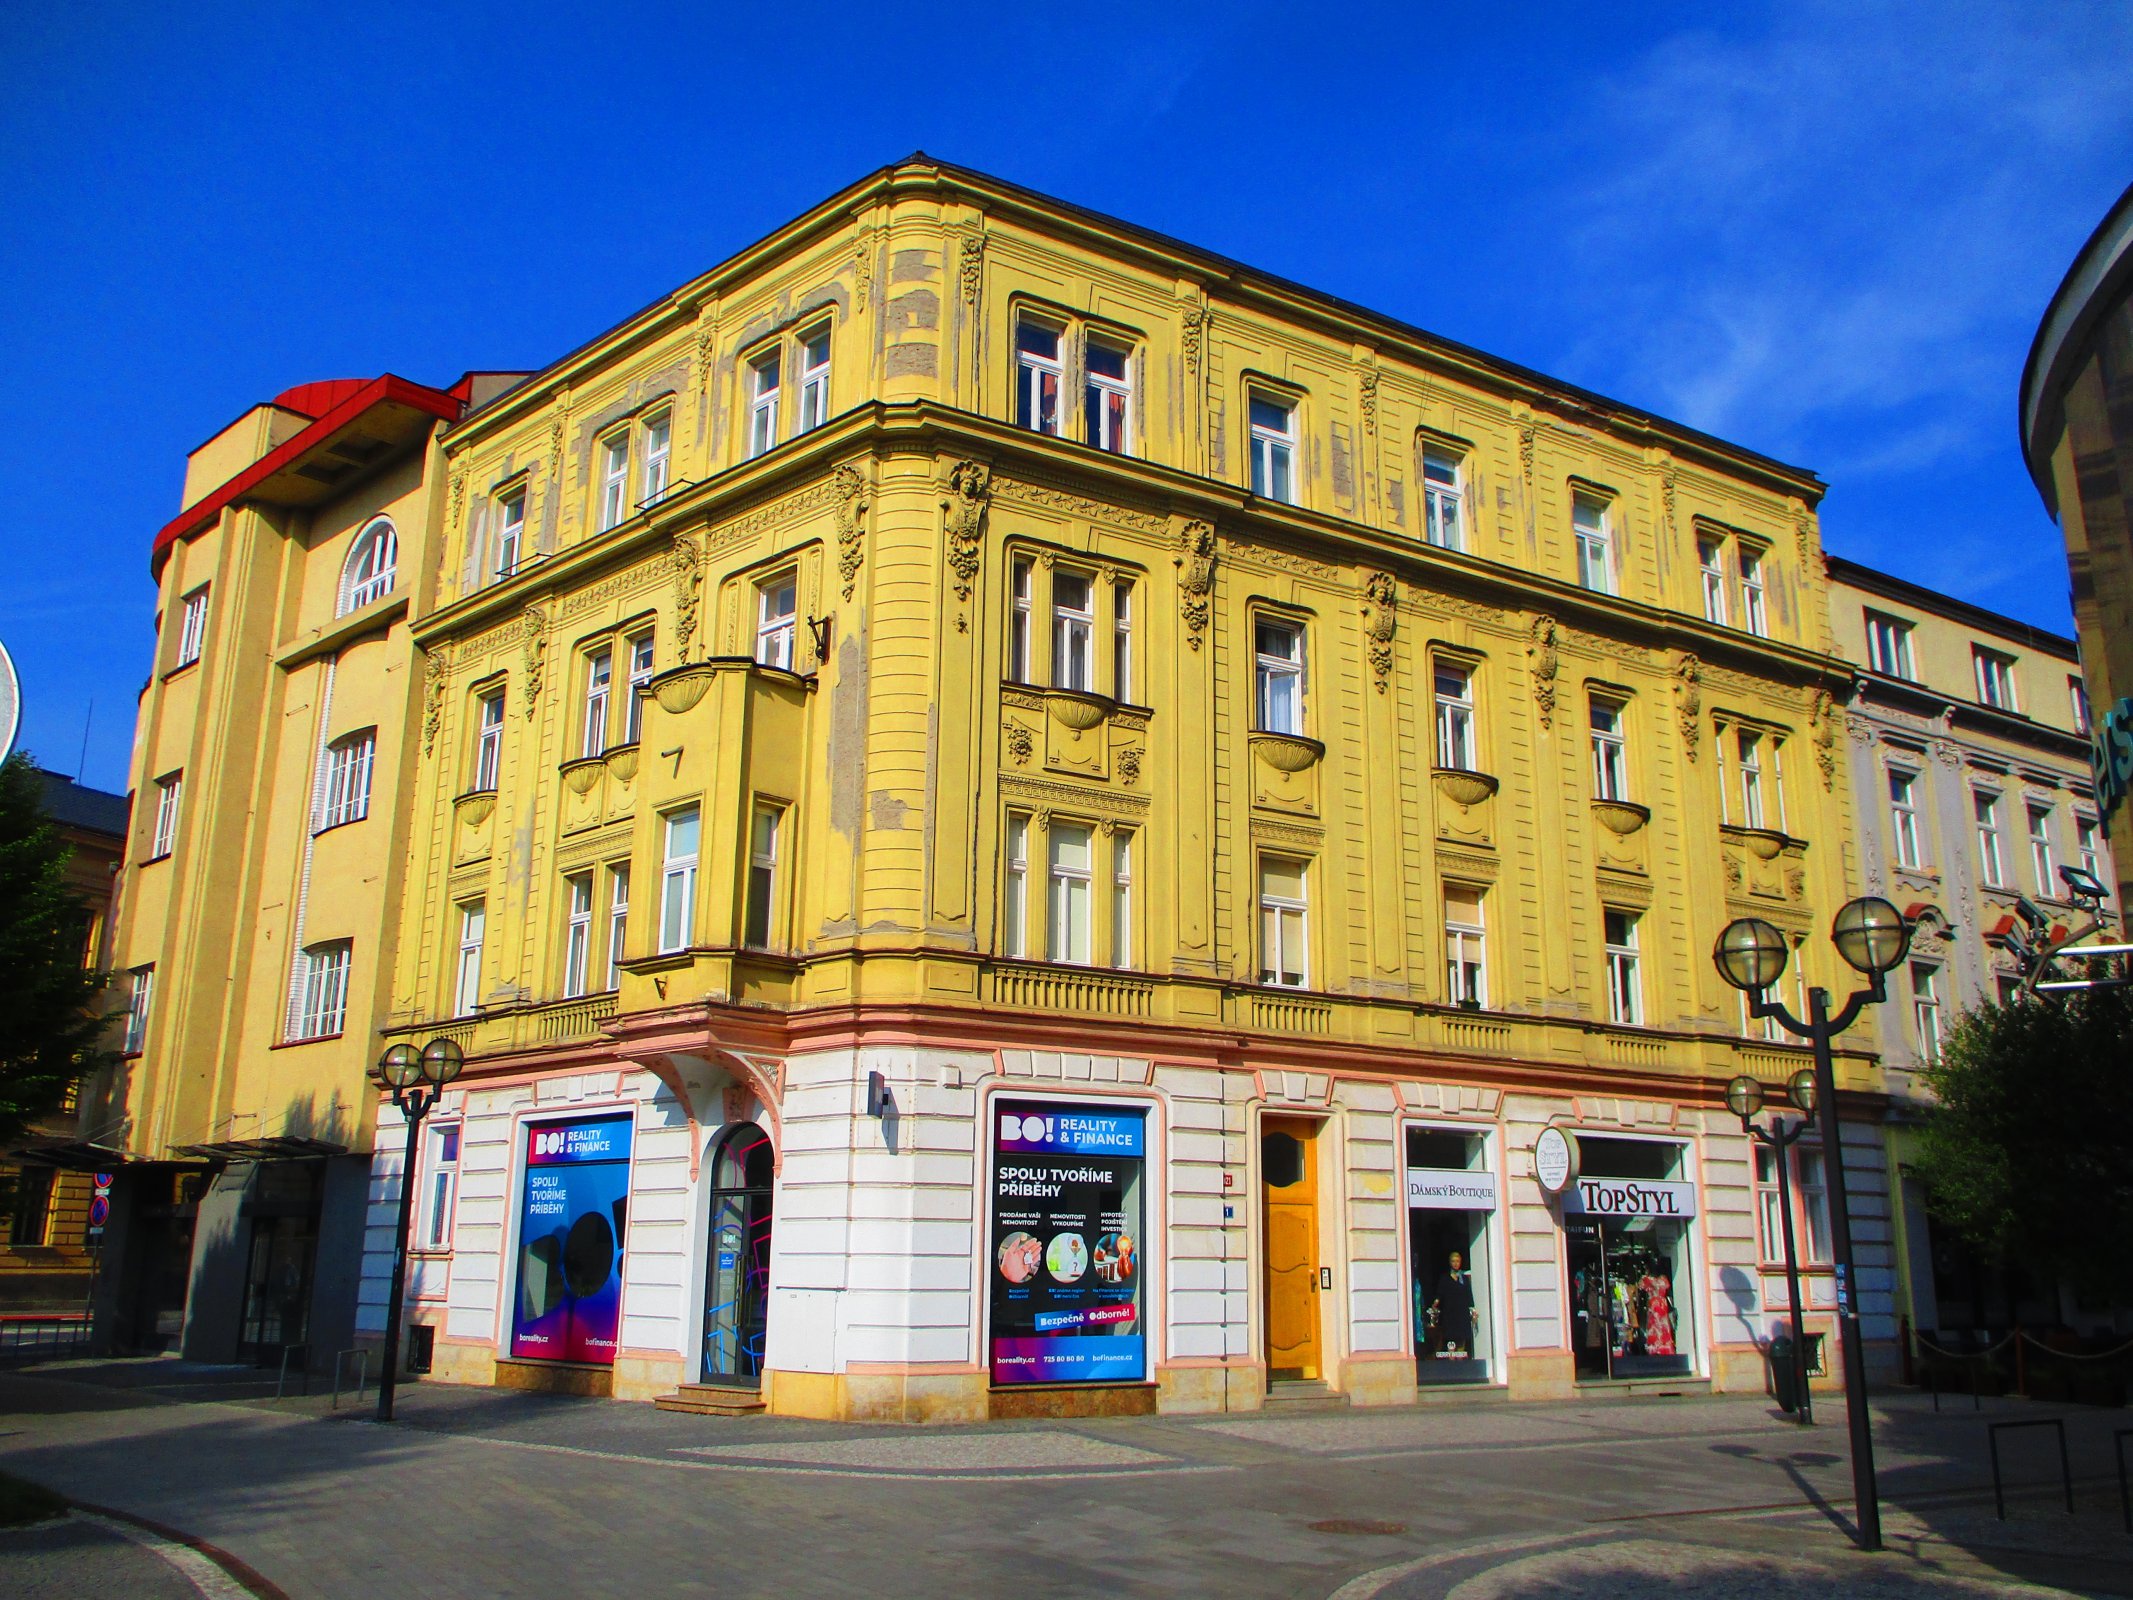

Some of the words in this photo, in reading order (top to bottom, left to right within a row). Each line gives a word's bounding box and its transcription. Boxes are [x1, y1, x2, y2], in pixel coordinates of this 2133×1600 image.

[1001, 1115, 1054, 1142] BO!
[1060, 1118, 1116, 1131] REALITY
[568, 1129, 602, 1142] REALITY
[1060, 1131, 1070, 1143] &
[1073, 1132, 1133, 1146] FINANCE
[535, 1132, 566, 1155] BO!
[566, 1142, 573, 1153] &
[574, 1140, 611, 1153] FINANCE
[532, 1176, 559, 1188] SPOLU
[1000, 1167, 1047, 1181] SPOLU
[1050, 1166, 1113, 1184] TVOŘÍME
[531, 1187, 567, 1201] TVOŘÍME
[999, 1180, 1062, 1198] PŘÍBĚHY
[1410, 1183, 1449, 1196] DÁMSKÝ
[1449, 1184, 1494, 1200] BOUTIQUE
[529, 1200, 565, 1215] PŘÍBĚHY
[1040, 1312, 1084, 1327] Bezpečně
[1089, 1308, 1130, 1321] Odborně!
[997, 1356, 1036, 1365] boreality.cz
[1043, 1355, 1056, 1364] 725
[1092, 1353, 1133, 1363] bofinance.cz
